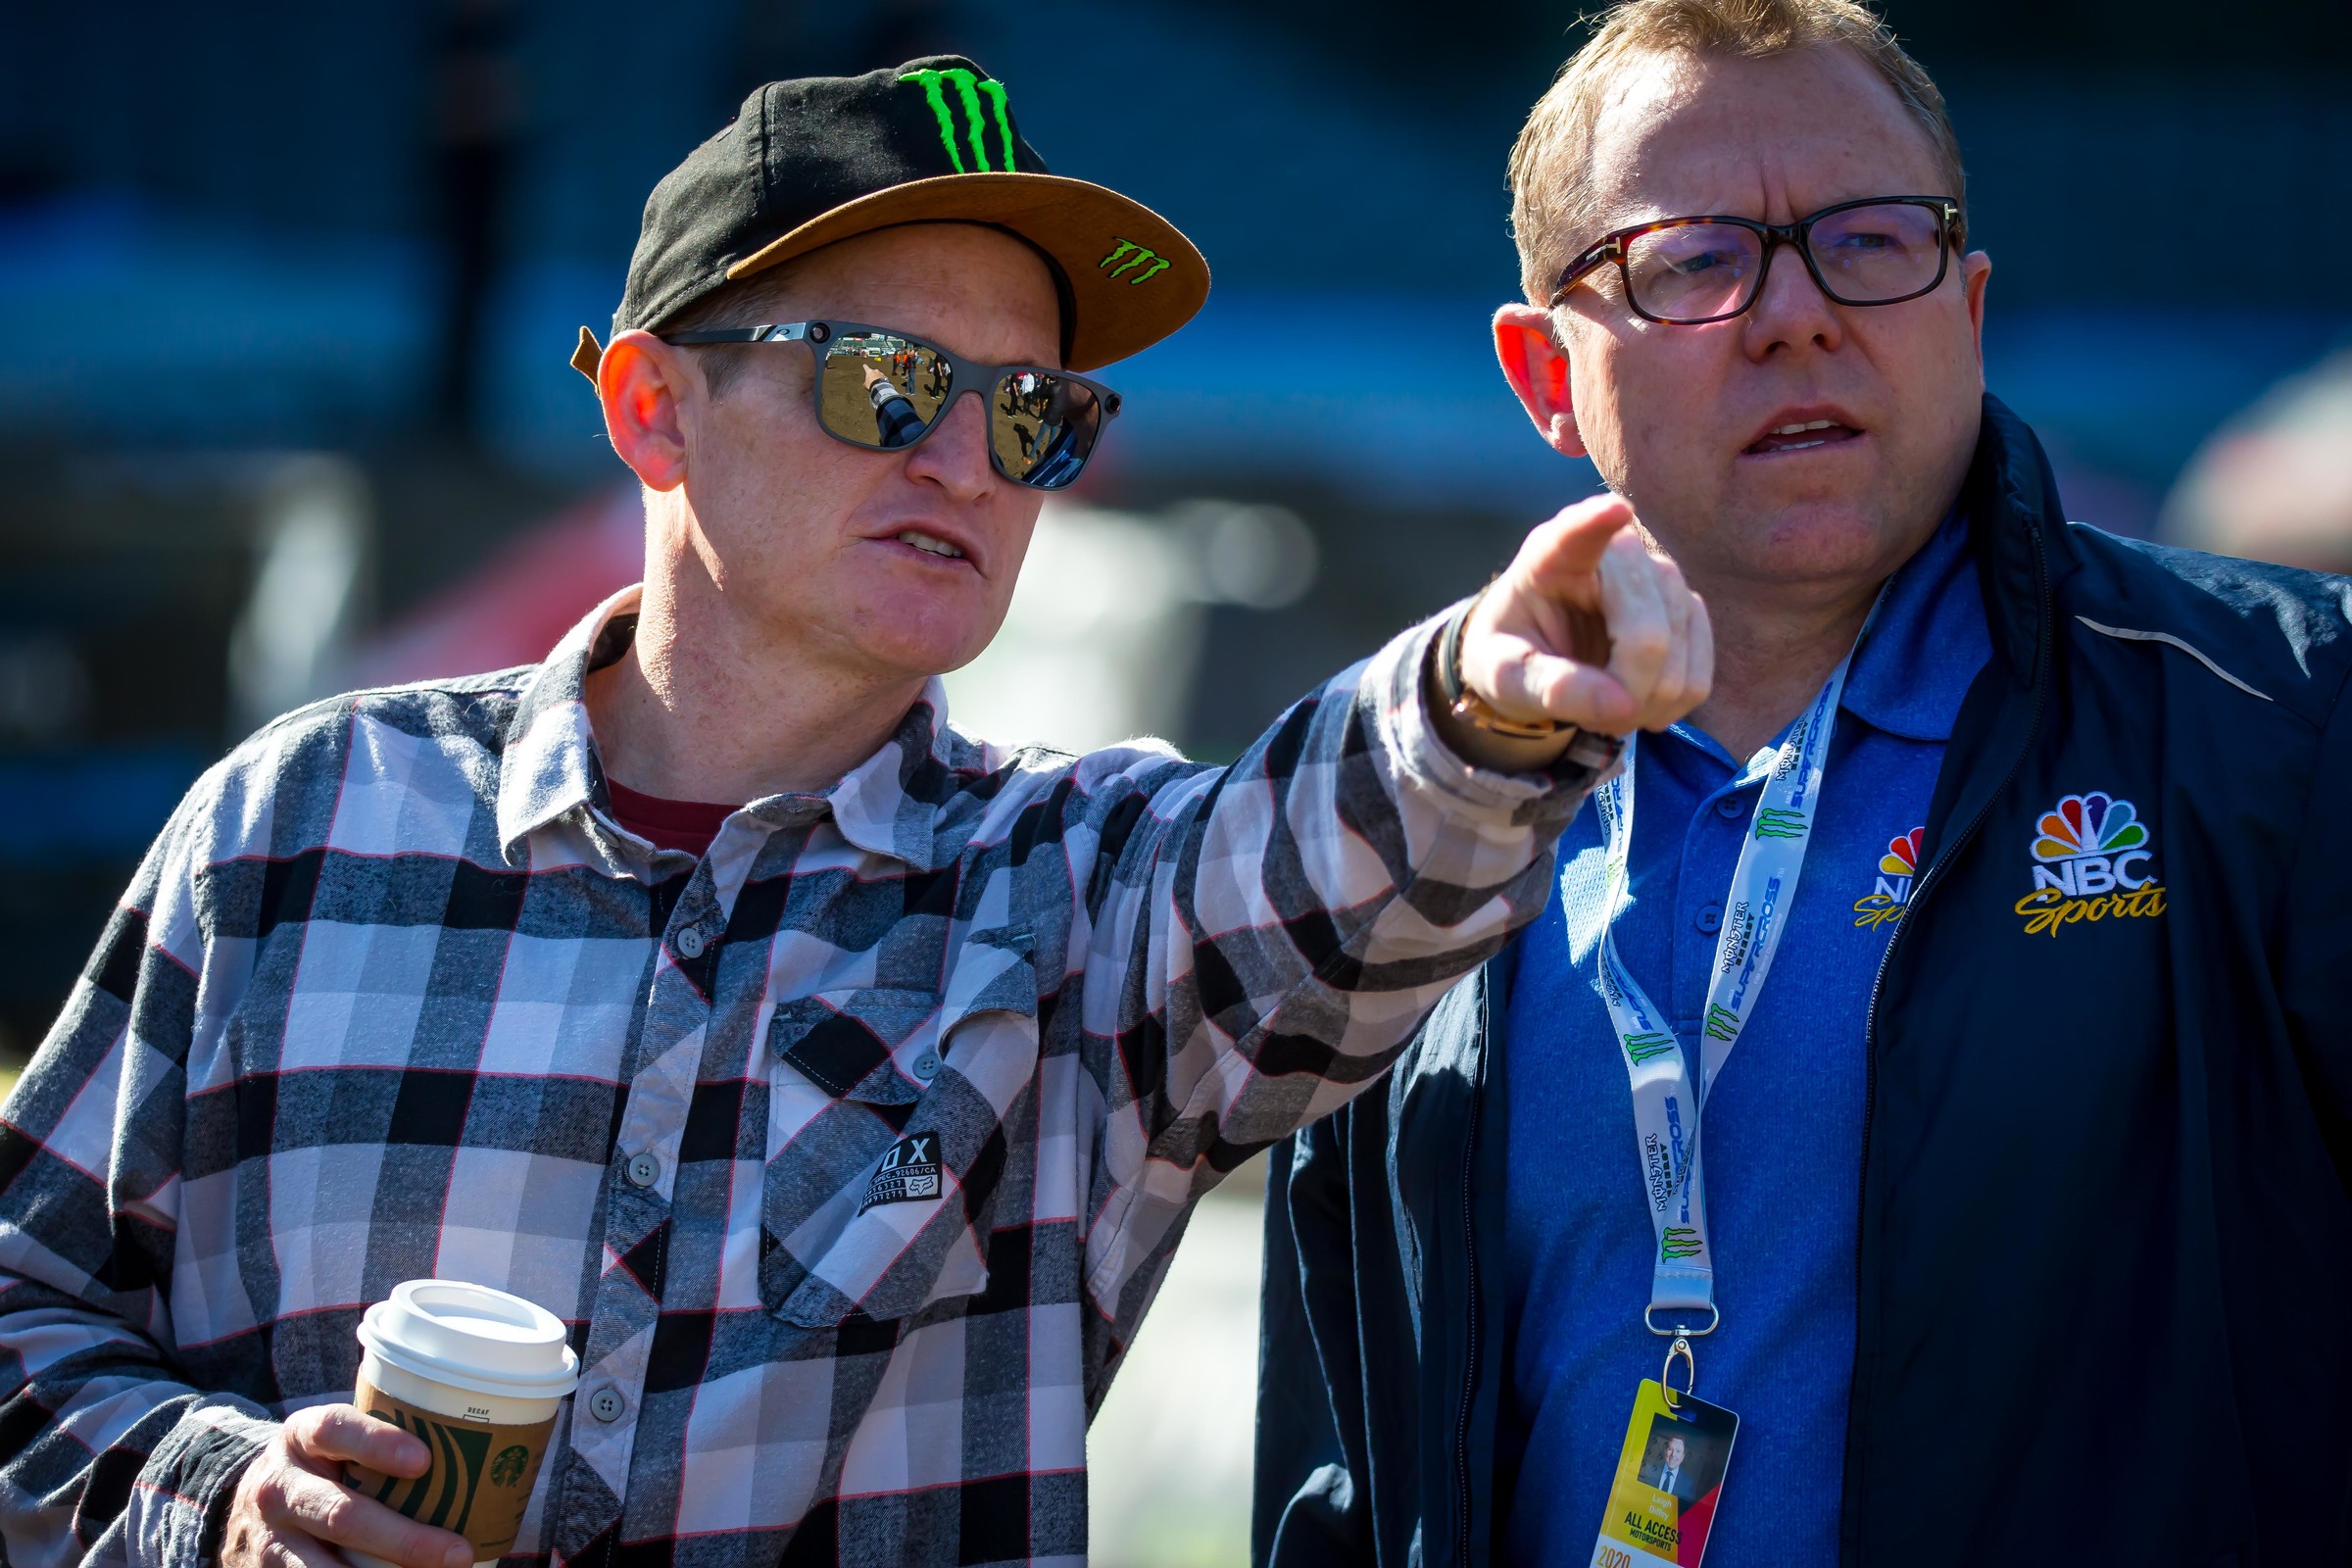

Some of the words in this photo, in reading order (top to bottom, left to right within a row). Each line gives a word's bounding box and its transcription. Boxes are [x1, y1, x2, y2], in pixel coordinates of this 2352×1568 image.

[2031, 850, 2158, 902] NBC
[2014, 882, 2167, 938] Sports
[1721, 901, 1749, 973] MONSTER
[1731, 876, 1781, 1012] SUPERCROSS
[1736, 912, 1754, 966] ENERGY
[881, 1138, 930, 1172] OX
[1645, 1133, 1667, 1212] MONSTER
[467, 1406, 490, 1415] DECAF
[1624, 1511, 1642, 1529] ALL
[1644, 1519, 1683, 1544] ACCESS
[1630, 1528, 1672, 1551] MOTORSPORTS
[1596, 1544, 1631, 1568] 2020
